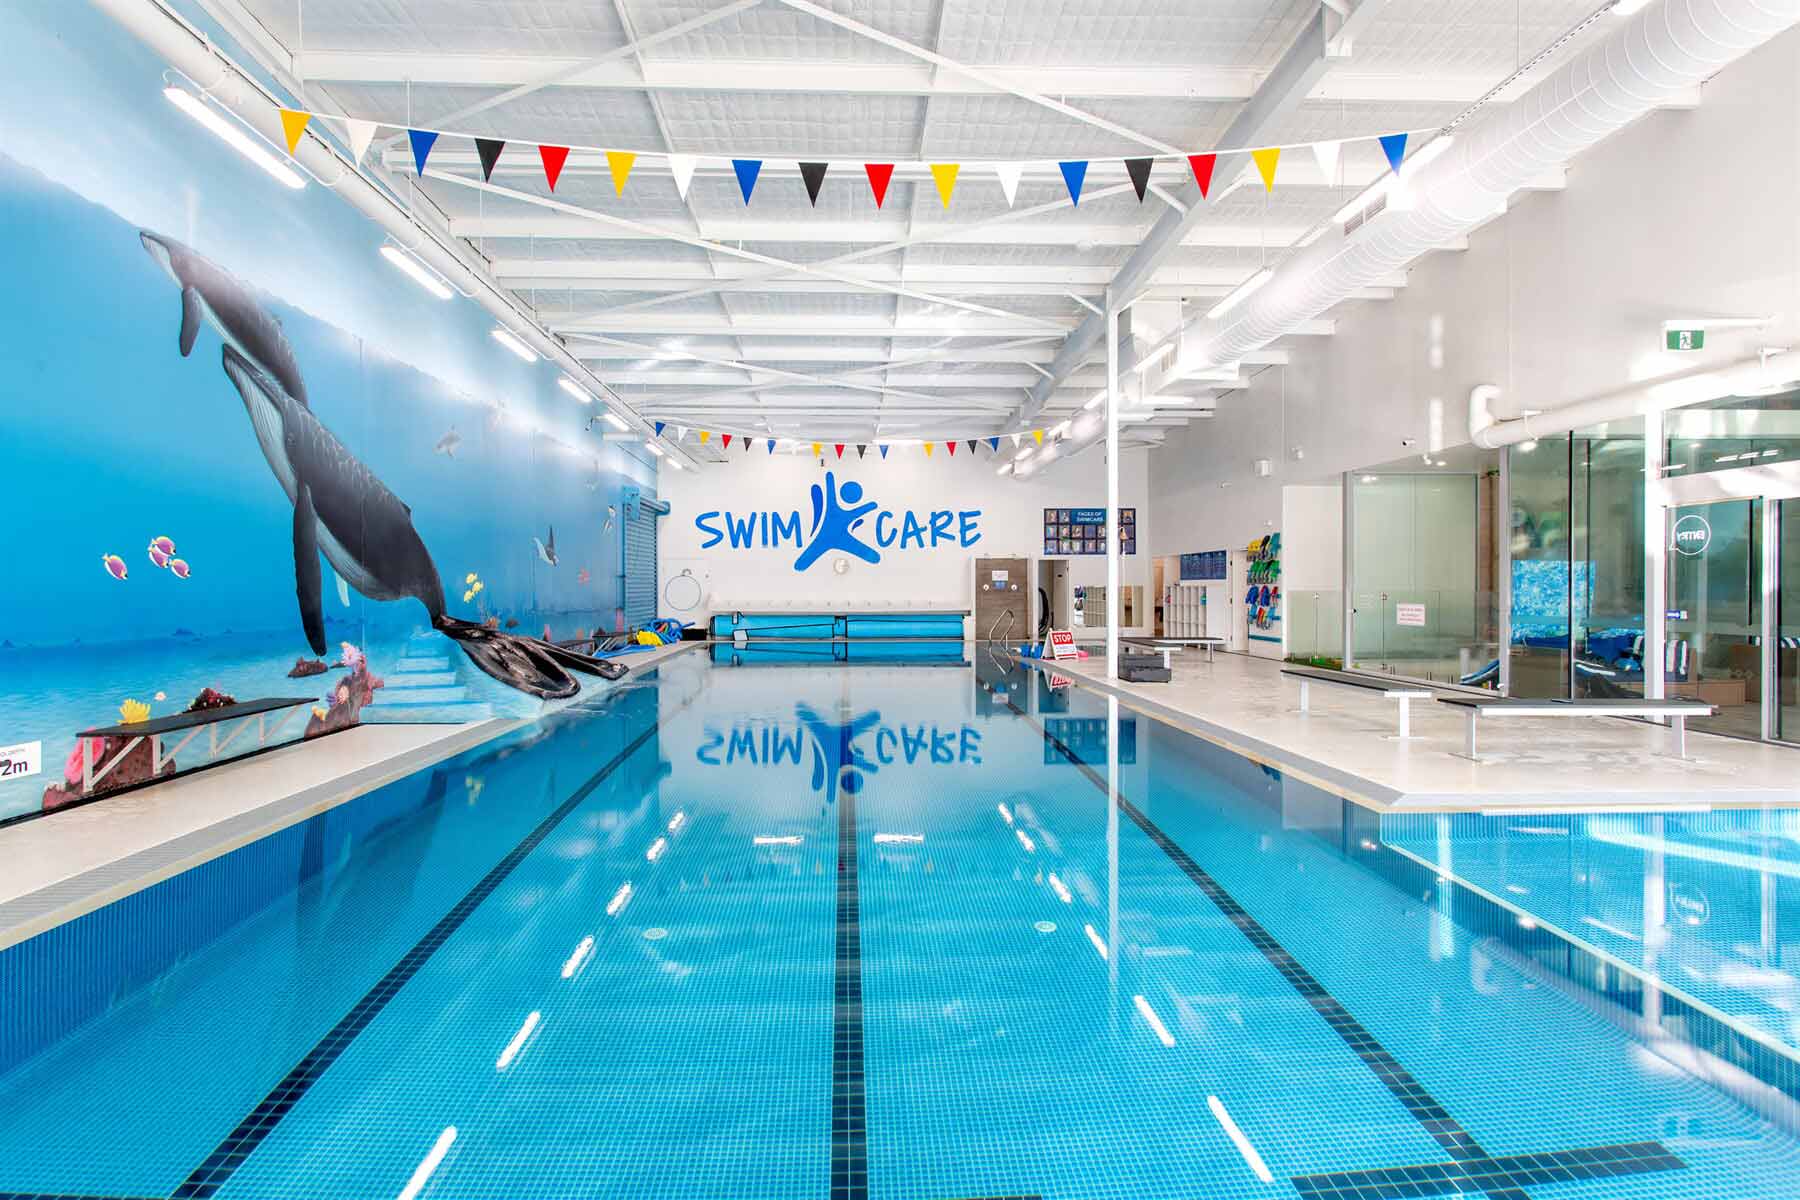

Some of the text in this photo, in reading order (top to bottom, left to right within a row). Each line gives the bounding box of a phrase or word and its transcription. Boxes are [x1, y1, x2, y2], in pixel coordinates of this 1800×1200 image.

[695, 510, 982, 549] SWIM CARE
[1053, 634, 1072, 643] STOP
